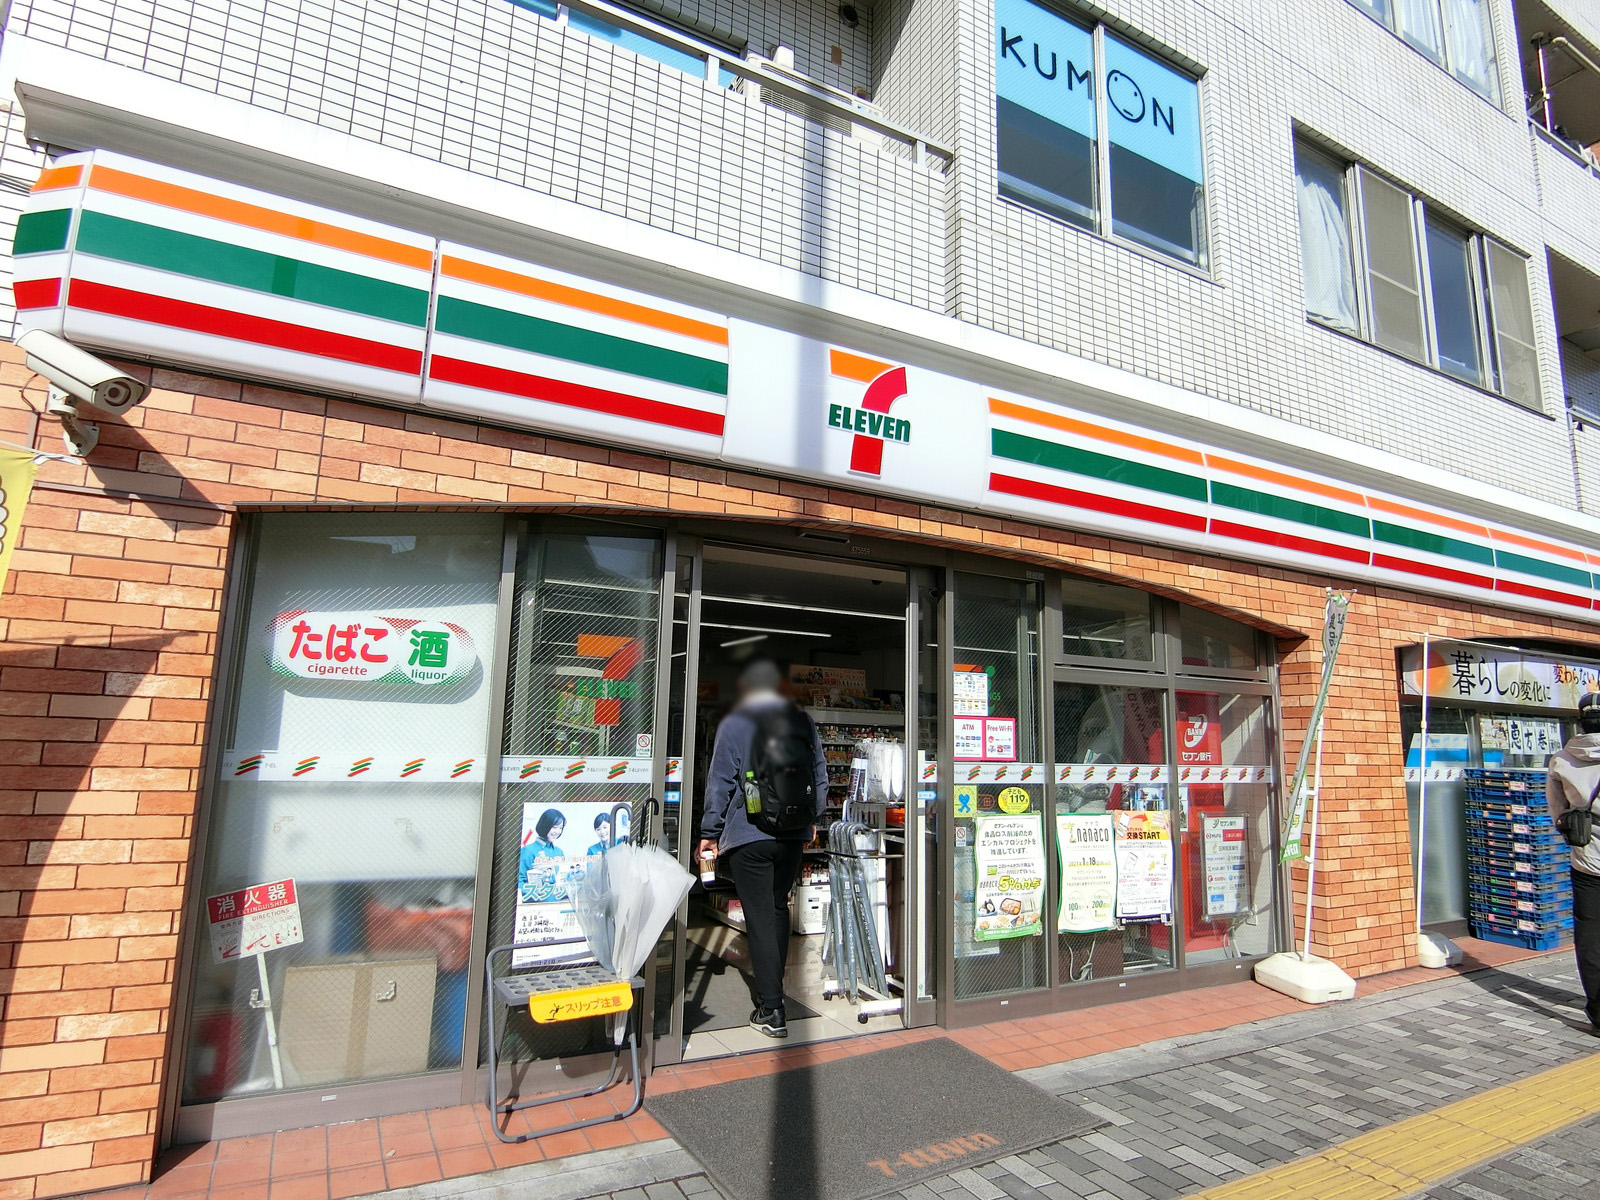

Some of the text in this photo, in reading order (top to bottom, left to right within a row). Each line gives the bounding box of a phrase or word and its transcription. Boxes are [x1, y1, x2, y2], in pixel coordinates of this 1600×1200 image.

[1000, 25, 1175, 136] KUMON
[288, 620, 451, 669] たばこ 酒
[307, 663, 448, 680] cigarette liquor
[1449, 650, 1600, 702] 暮らしの変化に 変わらない
[1181, 751, 1212, 762] セブン銀行
[981, 838, 1036, 846] エシカルプロジェクトを
[984, 830, 1033, 838] 食品ロス削減のため
[1076, 828, 1109, 842] nanaco
[216, 883, 287, 914] 消火器
[523, 883, 569, 901] スタッ
[218, 898, 289, 920] FIRE EXTINGUISHER
[251, 908, 290, 922] DIRECTIONS
[565, 995, 623, 1013] スリップ注意
